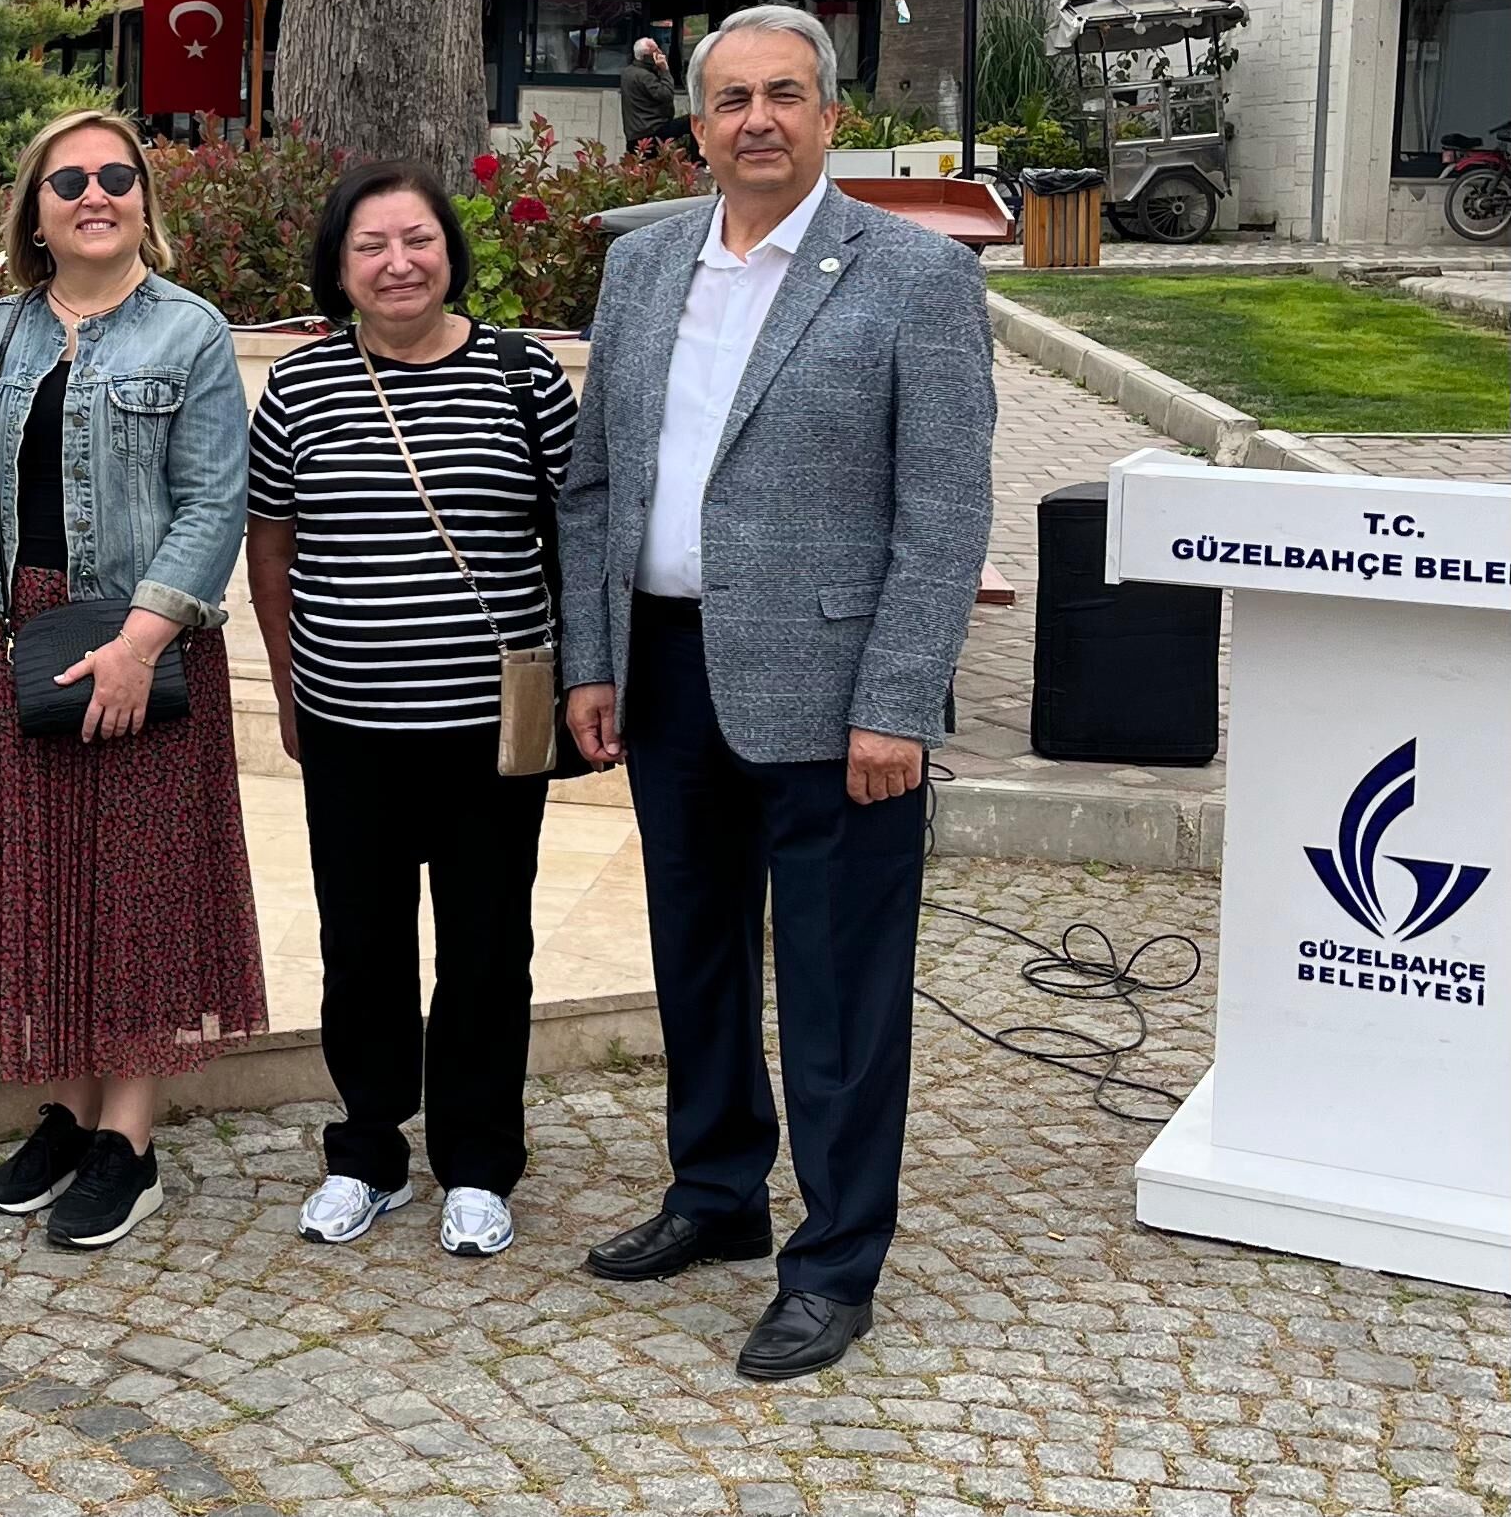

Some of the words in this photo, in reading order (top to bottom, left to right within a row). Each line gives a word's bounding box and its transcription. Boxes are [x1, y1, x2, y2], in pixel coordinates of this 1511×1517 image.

[1363, 512, 1425, 538] T.C.
[1172, 535, 1402, 580] GÜZELBAHÇE
[1415, 556, 1511, 585] BELE
[1299, 939, 1486, 983] GÜZELBAHÇE
[1298, 963, 1484, 1006] BELEDİYESİ
